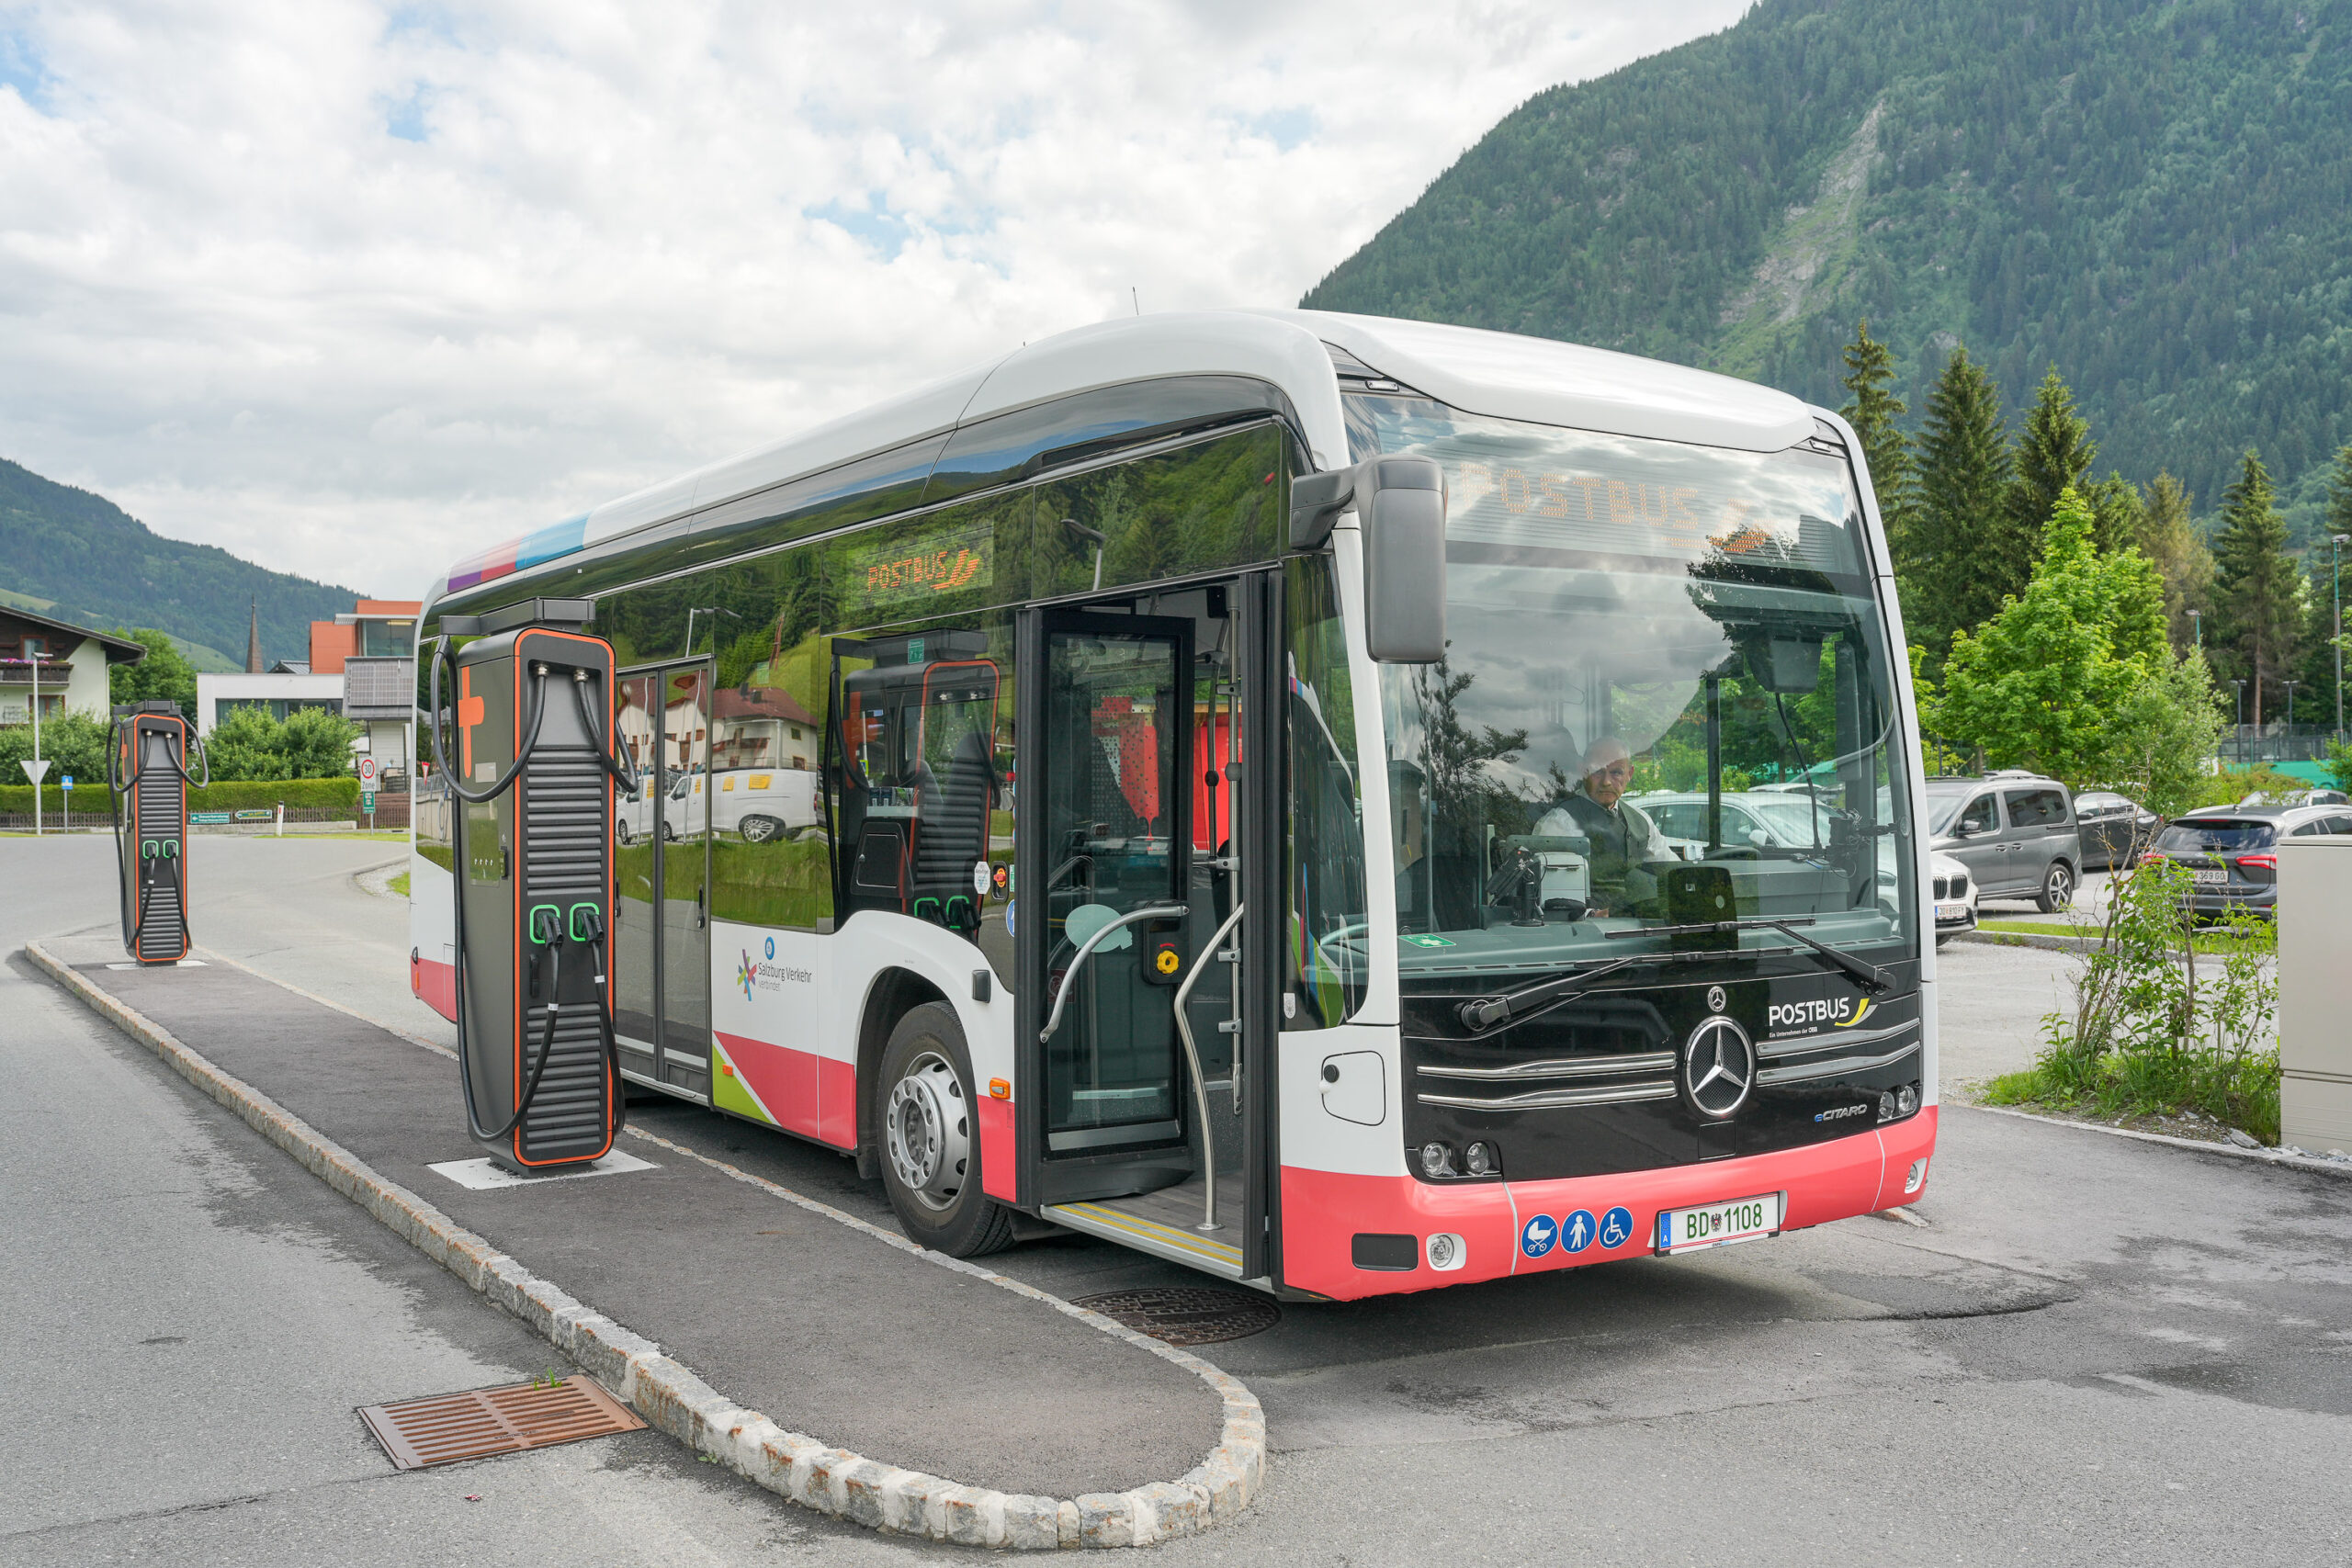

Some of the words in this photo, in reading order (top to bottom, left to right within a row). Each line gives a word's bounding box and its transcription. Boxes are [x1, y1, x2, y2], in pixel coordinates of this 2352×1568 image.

[1461, 462, 1698, 529] POSTBUS
[867, 551, 947, 592] POSTBUS
[364, 763, 372, 774] 30
[362, 781, 376, 790] Zone
[758, 962, 786, 982] Salzburg
[786, 967, 812, 983] Verkehr
[1769, 997, 1849, 1026] POSTBUS
[1777, 1029, 1801, 1038] Unternehmen
[1815, 1104, 1868, 1122] eCITARO
[1687, 1212, 1709, 1239] BD
[1724, 1202, 1762, 1233] 1108
[1662, 1234, 1669, 1243] A
